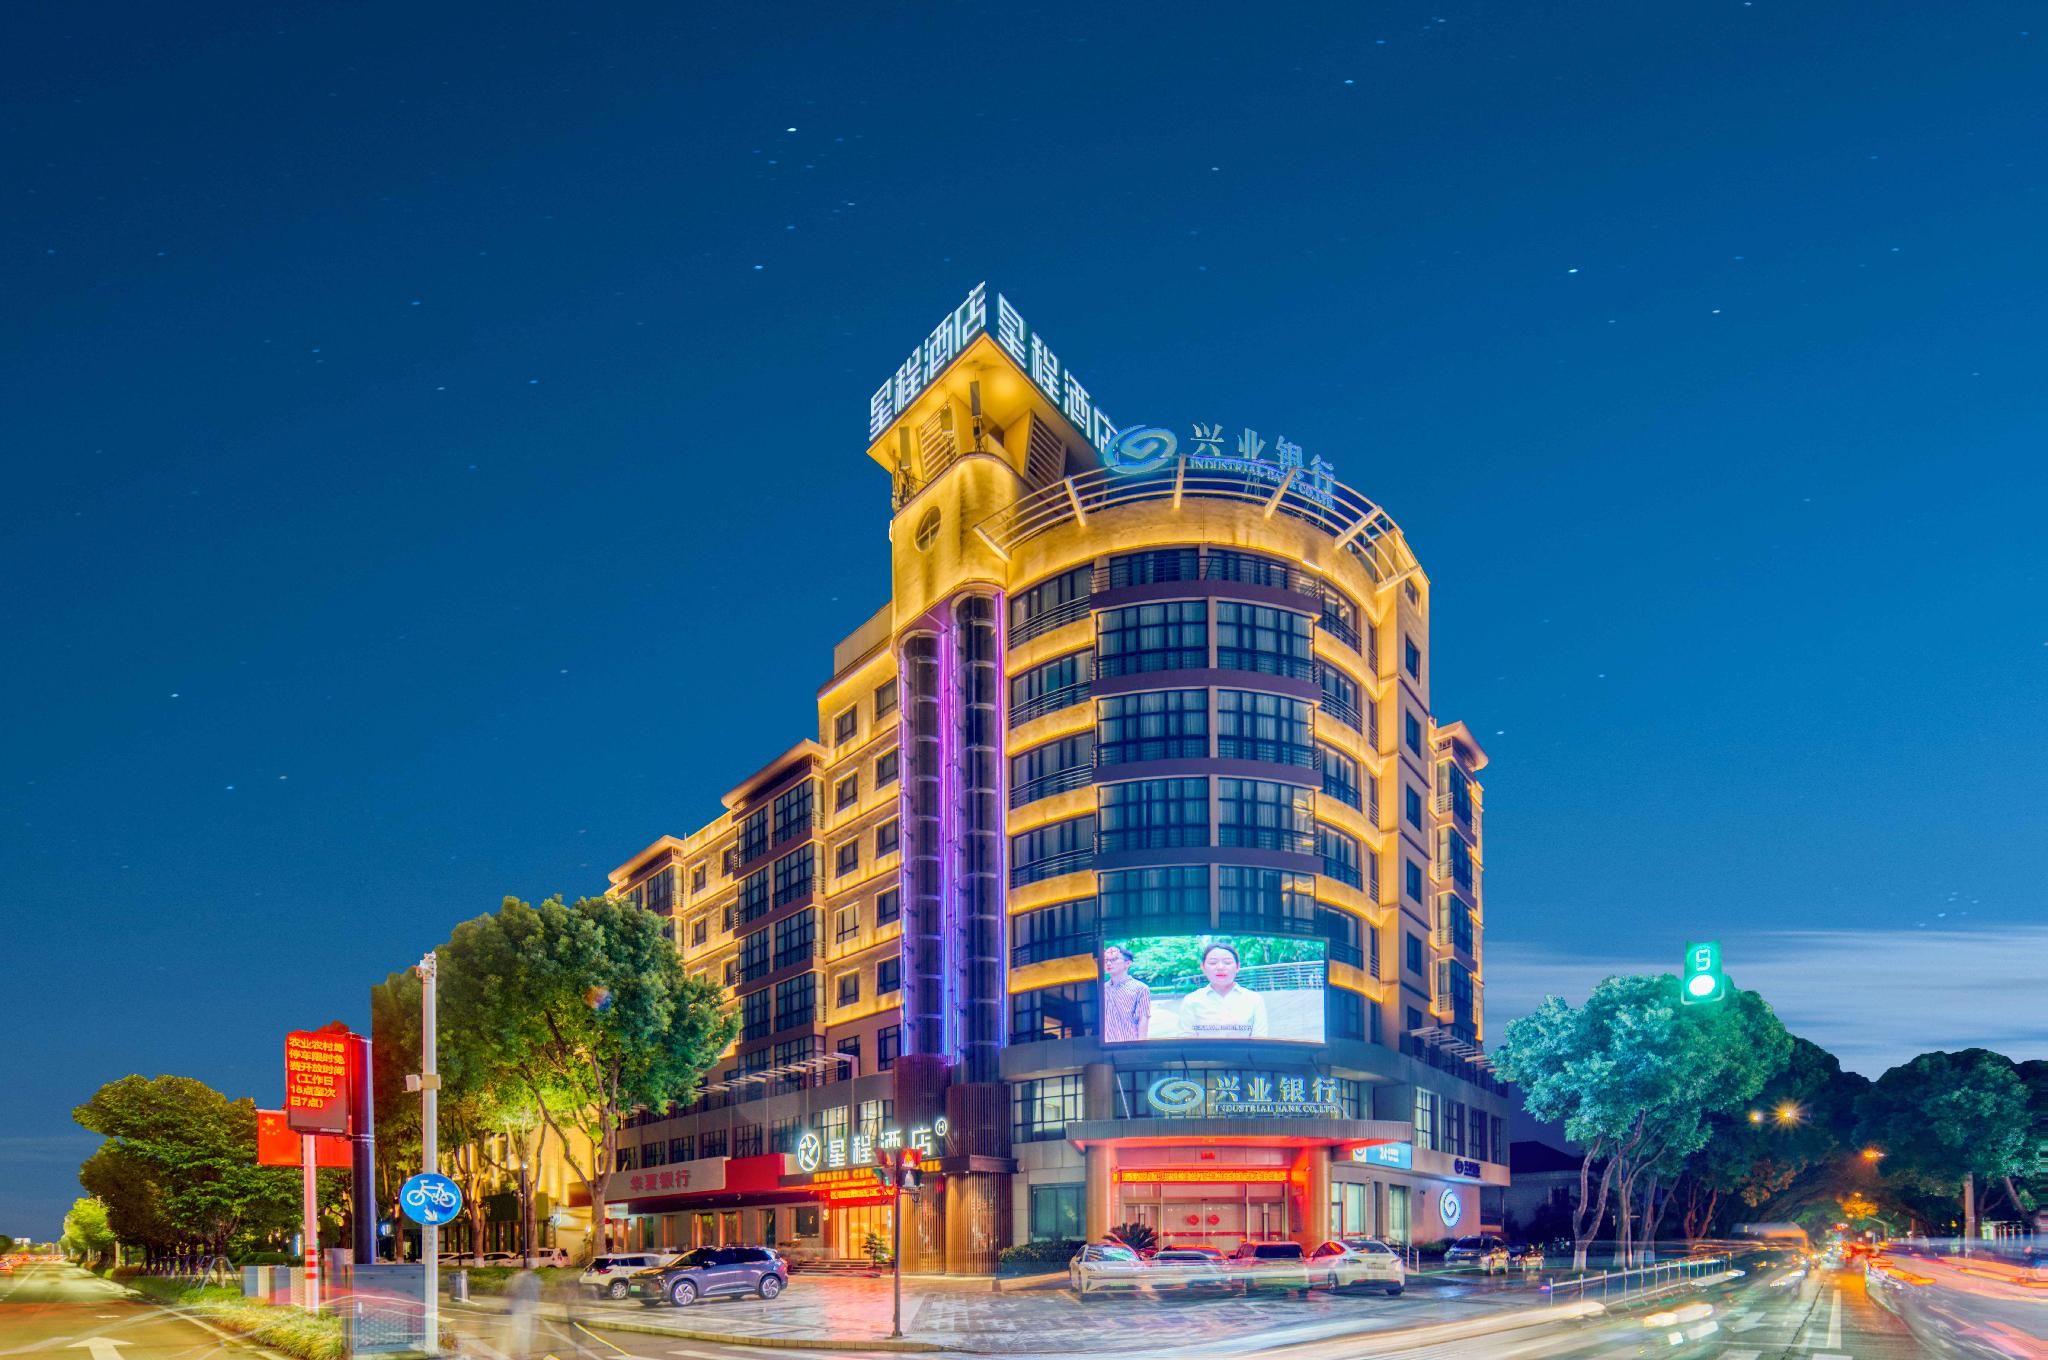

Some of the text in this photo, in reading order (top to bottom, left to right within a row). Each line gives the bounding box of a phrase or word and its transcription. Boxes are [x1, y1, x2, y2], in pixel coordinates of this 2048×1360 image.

[869, 280, 986, 441] 星程酒店
[1190, 421, 1335, 494] 兴业银行
[1189, 457, 1264, 478] INDUSTRIAL
[1267, 465, 1297, 490] BAK
[1215, 1076, 1337, 1102] 兴业银行
[1215, 1103, 1273, 1113] INDUSTRIAL
[1275, 1103, 1301, 1112] BANK
[630, 1169, 690, 1192] 华夏银行
